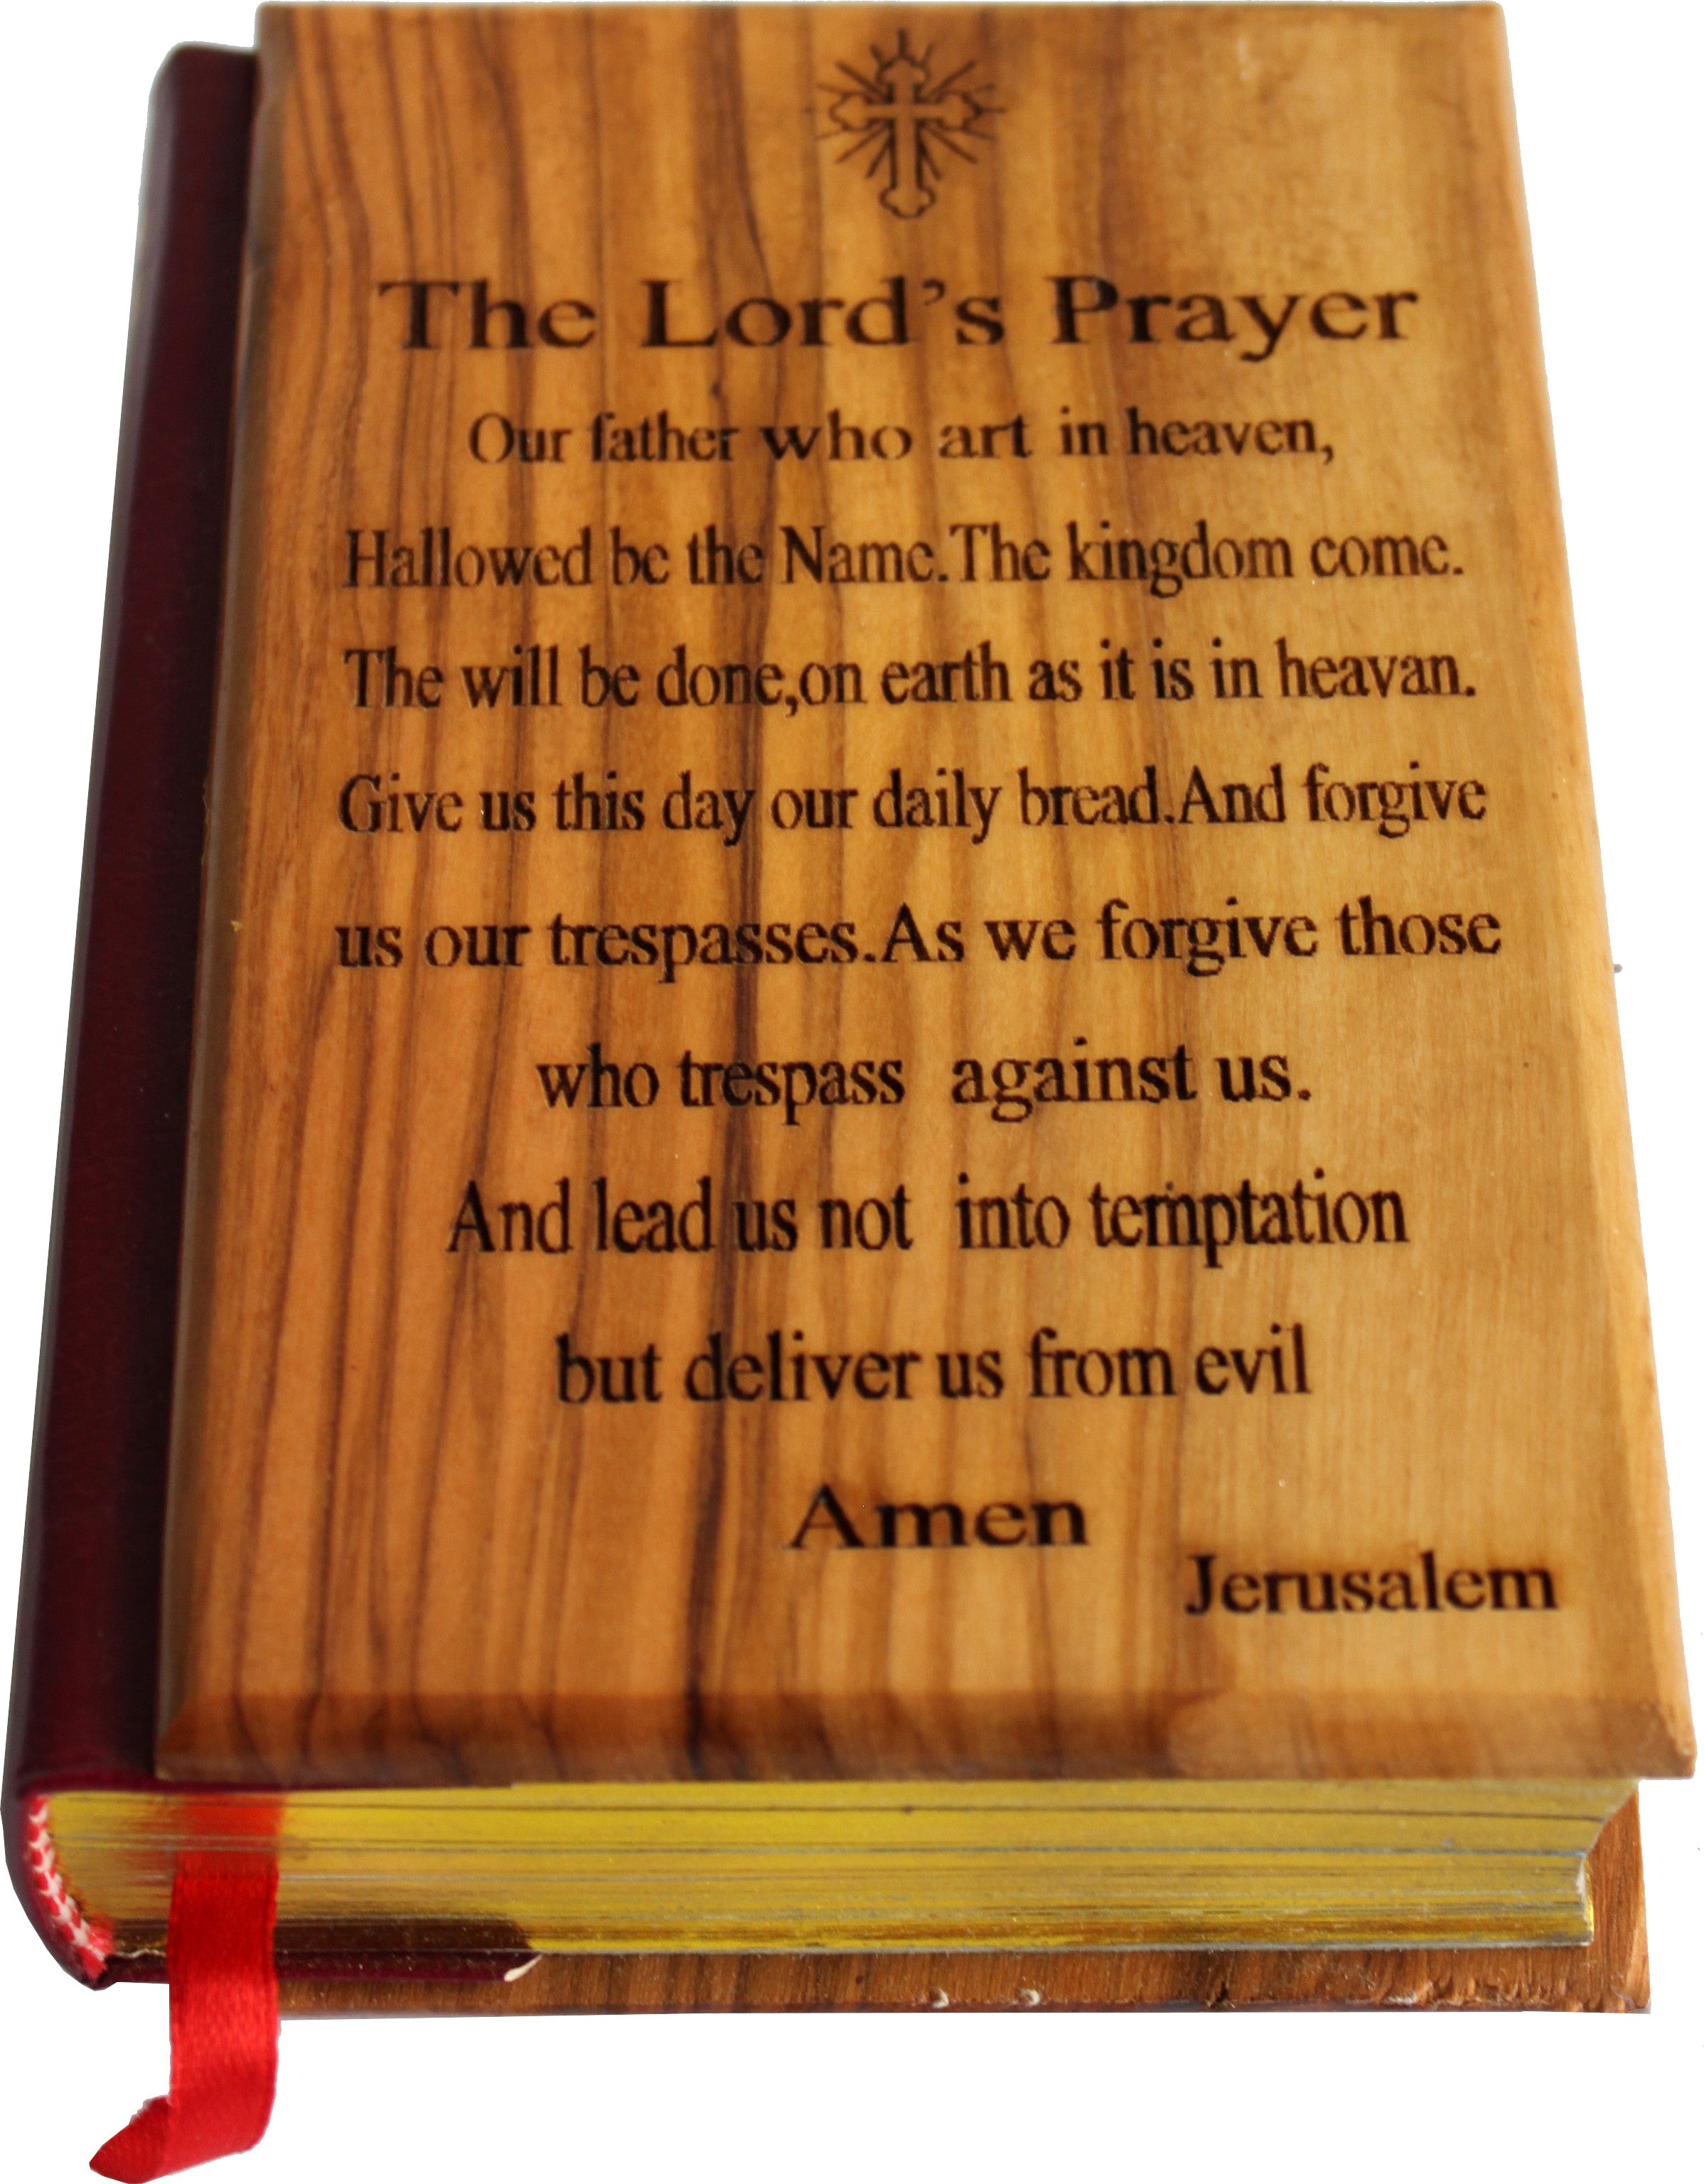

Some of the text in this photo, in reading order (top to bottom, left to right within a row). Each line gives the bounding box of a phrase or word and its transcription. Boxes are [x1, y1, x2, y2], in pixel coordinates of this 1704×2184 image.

[379, 274, 1418, 363] The Lord’s Prayer
[468, 406, 1334, 464] Our father who art in heaven,
[342, 525, 591, 588] Hallowed
[609, 525, 669, 586] be
[687, 525, 763, 586] the
[1066, 520, 1294, 599] kingdom
[1310, 533, 1464, 578] come.
[343, 645, 444, 710] The
[461, 643, 562, 709] will
[579, 644, 640, 708] be
[881, 640, 1014, 705] earth
[1028, 657, 1083, 703] as
[1100, 638, 1135, 702] it
[1152, 638, 1194, 701] is
[1211, 638, 1263, 700] in
[1275, 637, 1477, 700] heavan.
[338, 772, 463, 833] Give
[479, 788, 536, 833] us
[552, 771, 645, 832] this
[662, 769, 757, 847] day
[770, 786, 859, 830] our
[873, 768, 1003, 845] daily
[1303, 761, 1487, 840] forgive
[334, 924, 403, 968] us
[424, 924, 532, 968] our
[984, 917, 1076, 961] we
[1098, 896, 1318, 977] forgive
[1335, 895, 1502, 957] those
[536, 1037, 1312, 1126] who trespass against us.
[445, 1169, 1409, 1269] And lead us not into temptation
[555, 1322, 1313, 1403] but deliver us from evil
[784, 1484, 1089, 1551] Amen
[1184, 1551, 1558, 1616] Jerusalem
